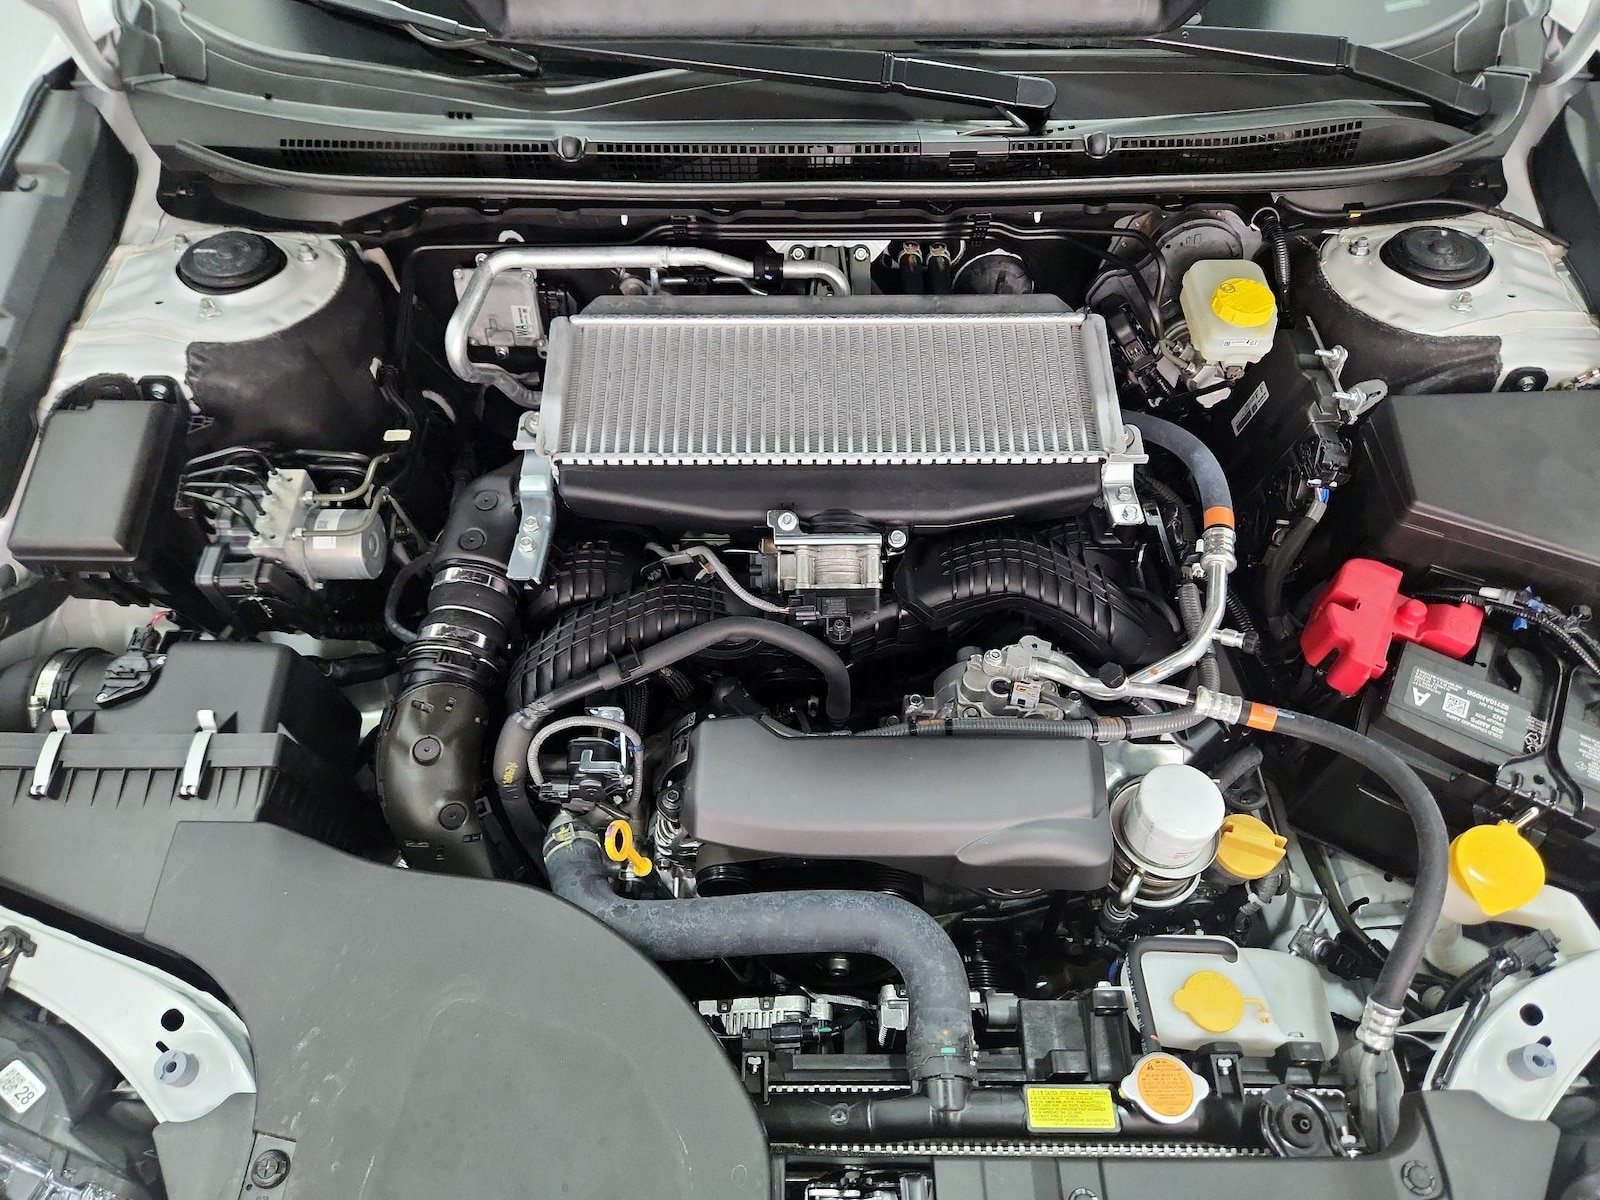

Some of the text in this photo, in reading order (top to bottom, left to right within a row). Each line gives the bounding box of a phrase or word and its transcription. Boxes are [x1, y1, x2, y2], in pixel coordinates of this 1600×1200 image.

[1445, 712, 1502, 738] COLD CRANKING AMPS
[1469, 716, 1490, 728] AMPS
[1486, 716, 1504, 727] GROUP
[14, 1086, 34, 1104] 28
